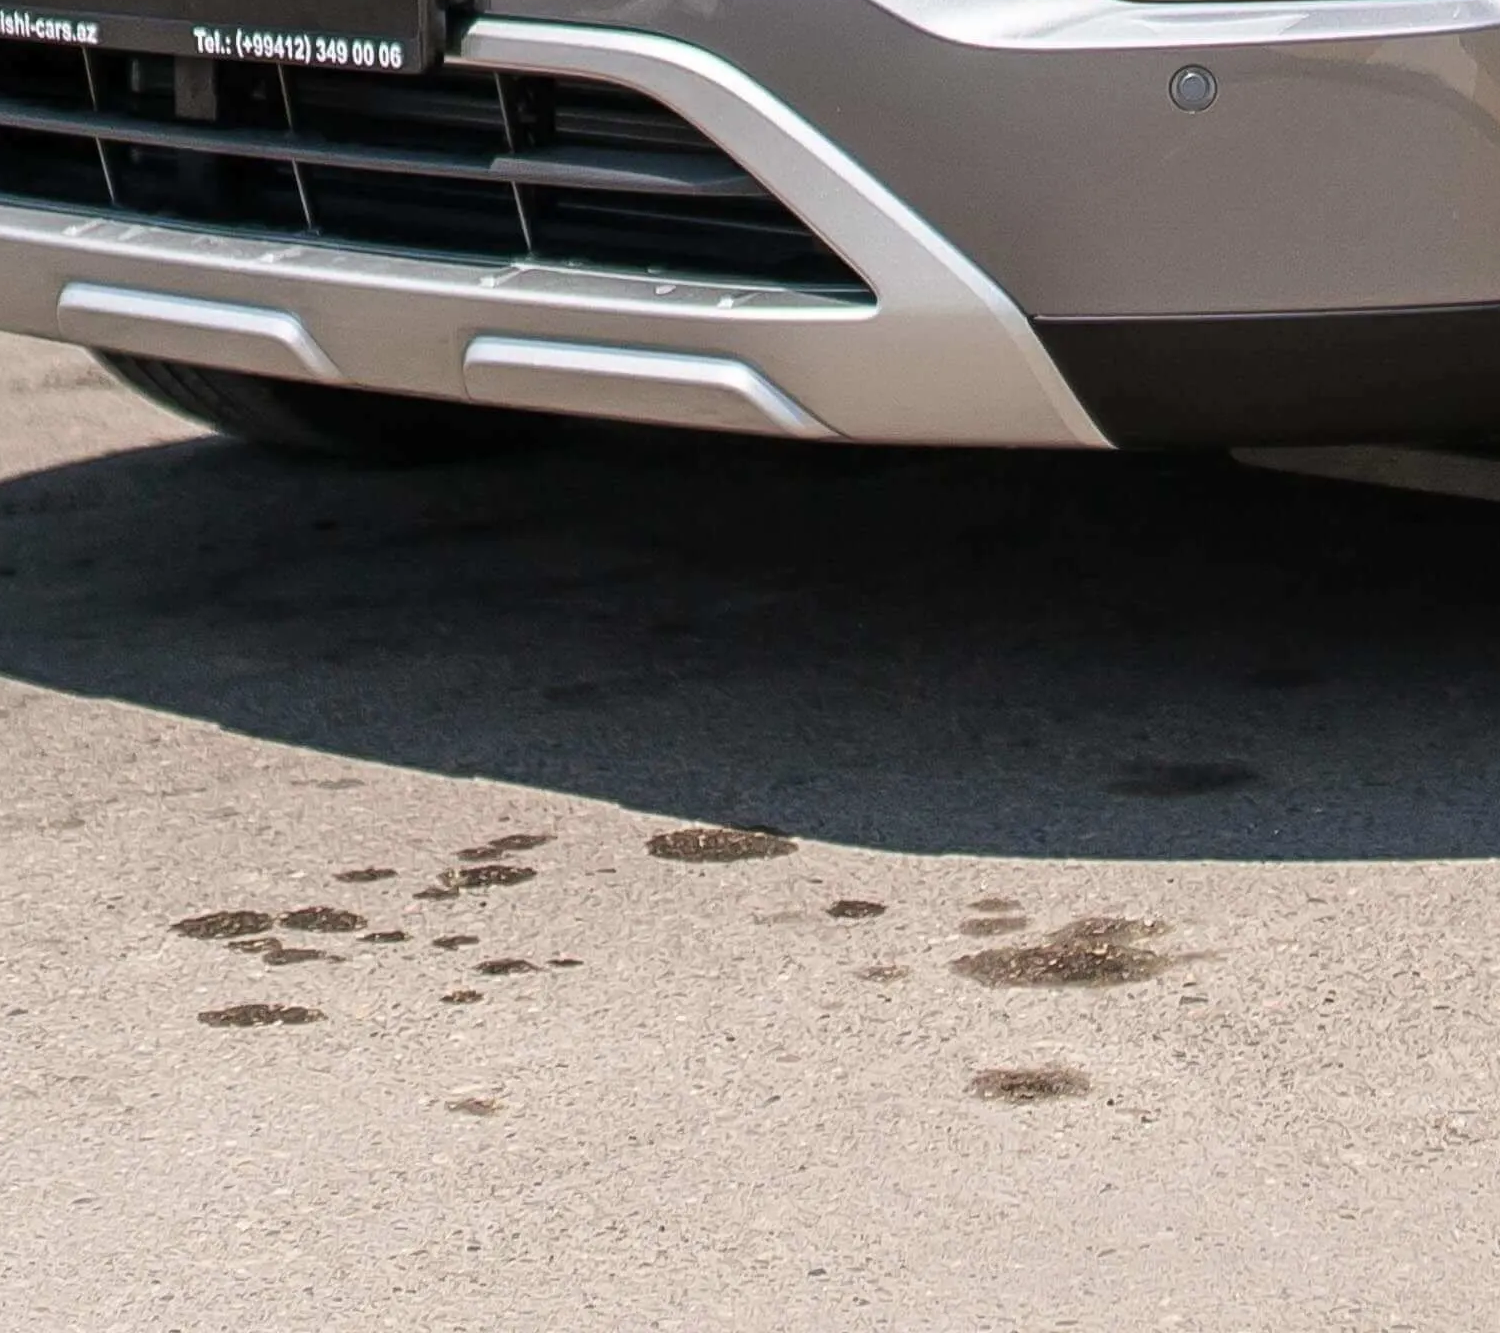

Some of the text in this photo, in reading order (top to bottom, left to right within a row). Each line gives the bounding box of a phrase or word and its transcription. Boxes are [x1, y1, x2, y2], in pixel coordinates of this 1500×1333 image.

[235, 28, 312, 65] (+99412)
[315, 36, 349, 65] 349
[352, 39, 375, 67] 00
[379, 41, 403, 69] 06
